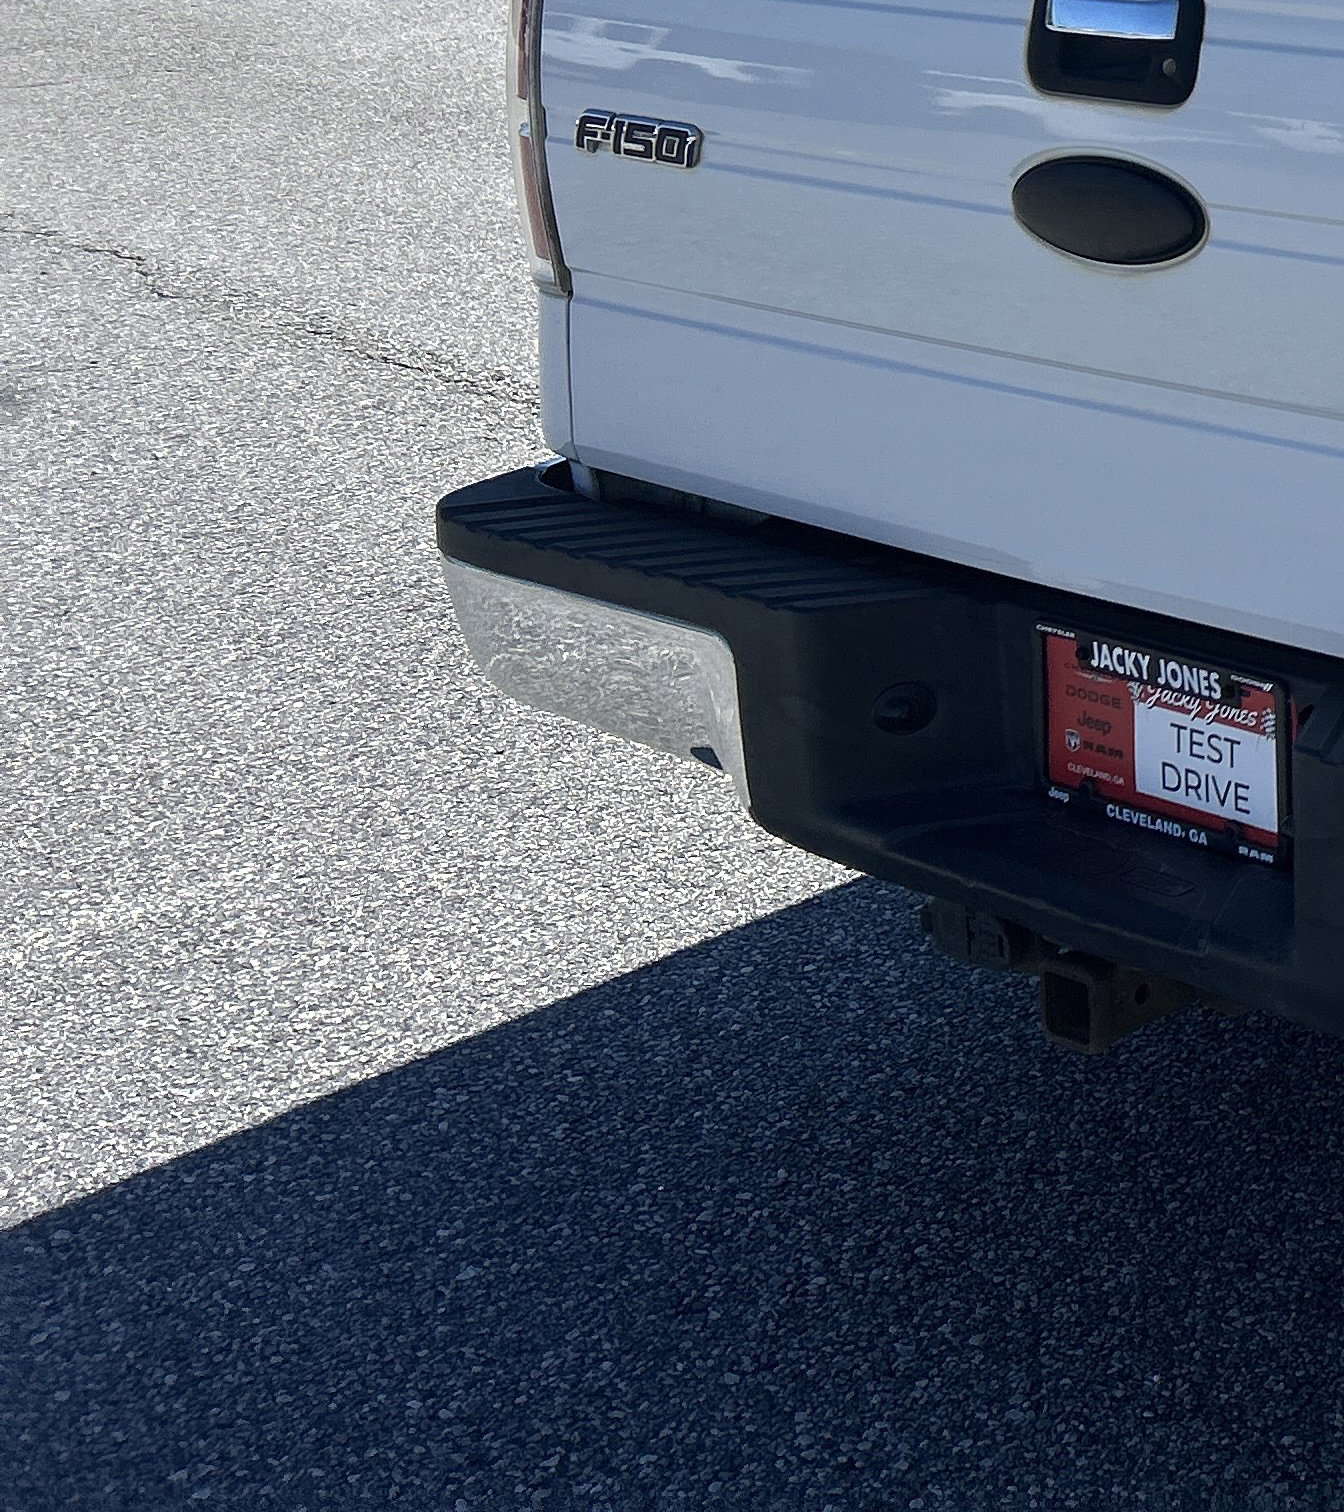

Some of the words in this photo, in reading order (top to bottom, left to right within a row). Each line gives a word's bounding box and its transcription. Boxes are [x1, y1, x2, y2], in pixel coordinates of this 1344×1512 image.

[1090, 641, 1150, 681] JACKY
[1157, 658, 1222, 700] JONES
[1065, 684, 1122, 709] DODGE
[1077, 710, 1113, 737] Jeep
[1082, 741, 1124, 761] RAM
[1170, 722, 1241, 769] TEST
[1161, 761, 1251, 815] DRIVE
[1189, 829, 1208, 846] GA
[1237, 845, 1275, 863] RAM
